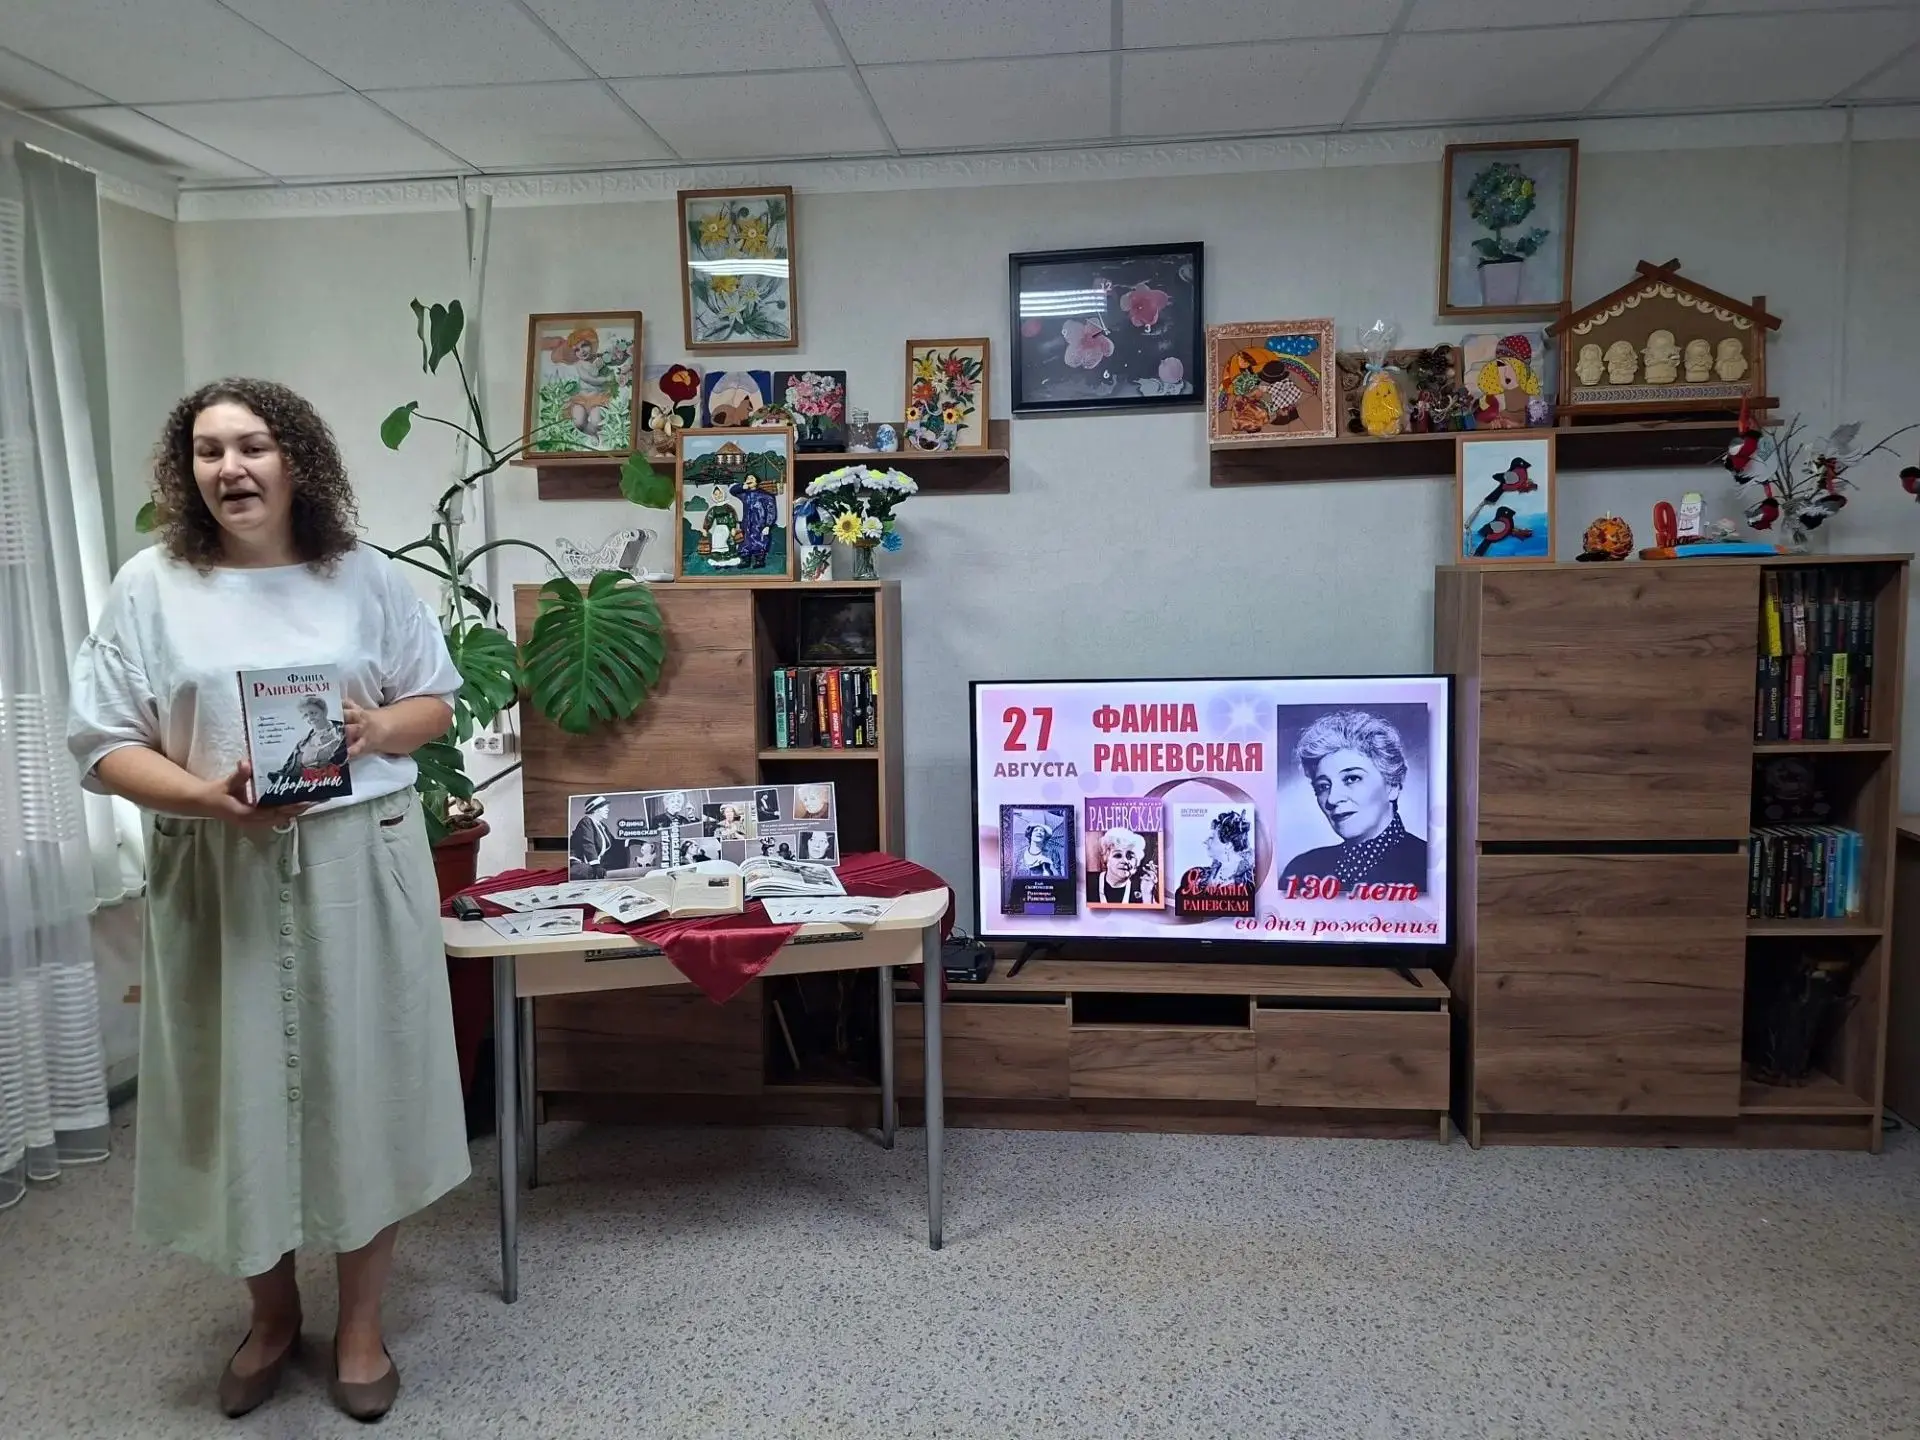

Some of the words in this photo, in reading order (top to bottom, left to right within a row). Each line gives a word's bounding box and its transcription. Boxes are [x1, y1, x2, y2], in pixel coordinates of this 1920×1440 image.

[1100, 282, 1112, 291] 12
[1144, 324, 1152, 333] 3
[1103, 370, 1110, 379] 6
[1002, 707, 1053, 751] 27
[1092, 703, 1198, 733] ФАИНА
[1094, 742, 1263, 772] РАНЕВСКАЯ
[993, 762, 1079, 778] АВГУСТА
[266, 775, 343, 796] Афоризмы
[1089, 806, 1163, 832] РАНЕВСКАЯ
[1181, 868, 1203, 895] Я
[1284, 874, 1341, 900] 130
[1347, 882, 1419, 901] лет
[1183, 899, 1249, 912] РАНЕВСКАЯ
[1235, 921, 1258, 931] со
[1264, 914, 1306, 932] дня
[1312, 916, 1439, 937] рождения
